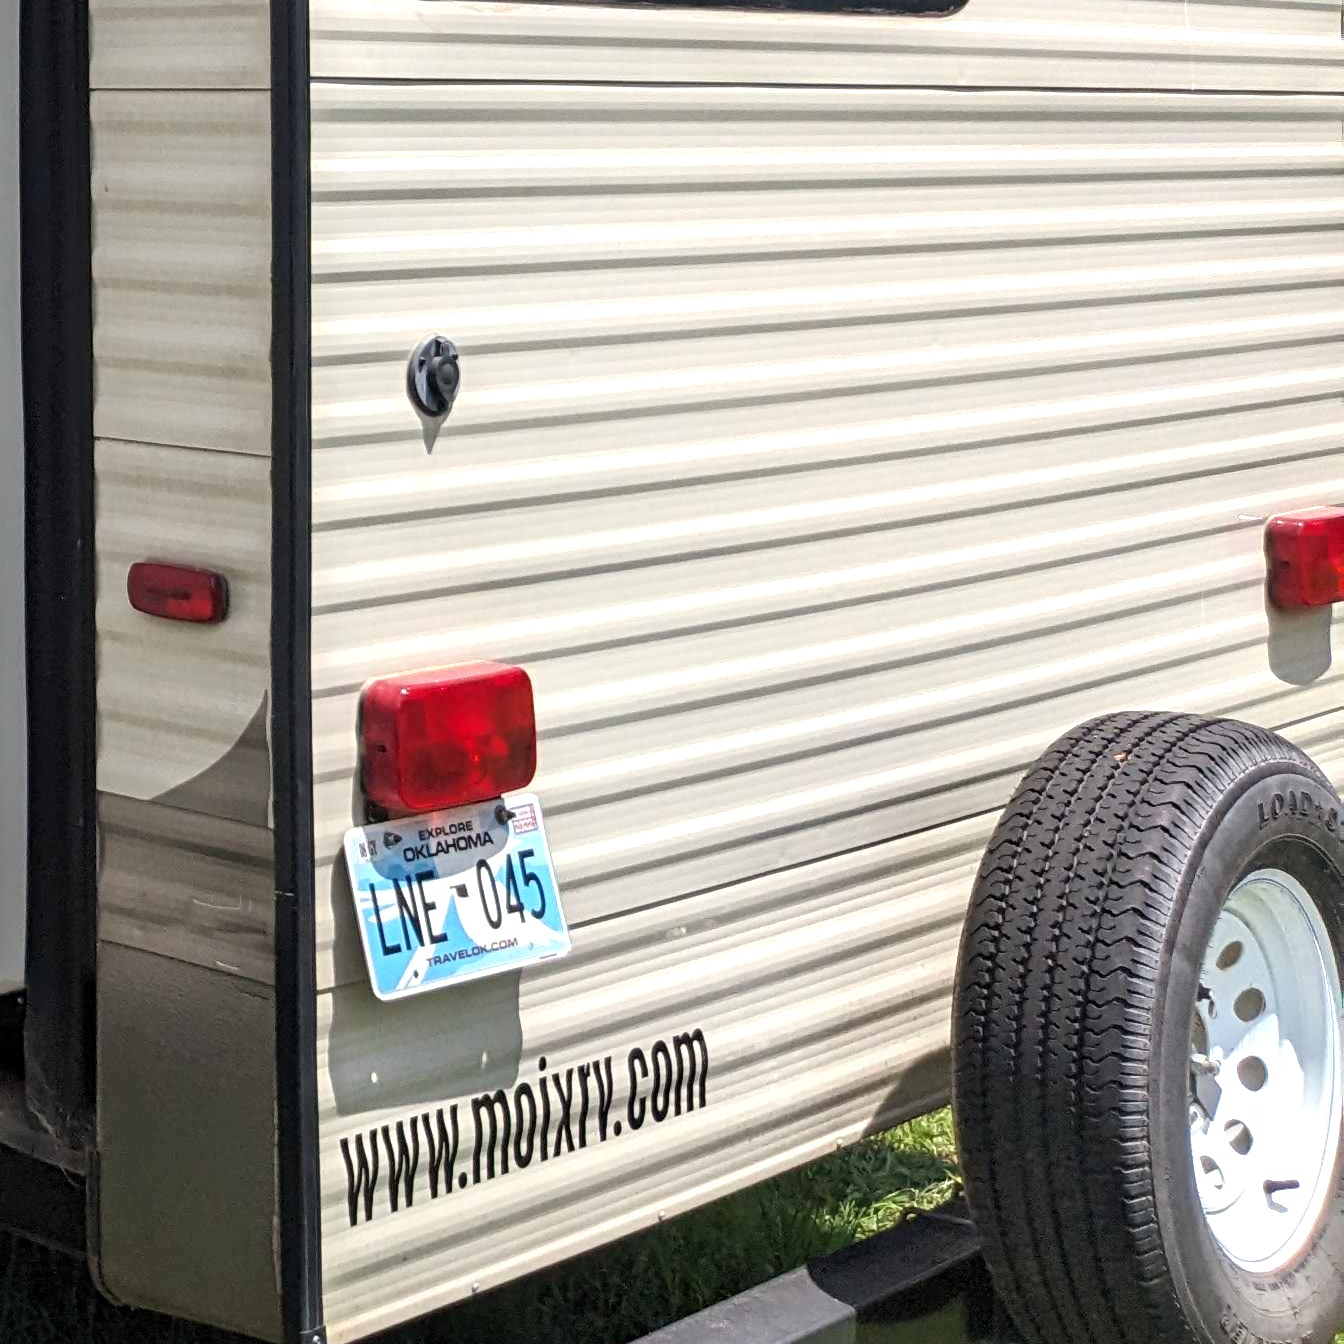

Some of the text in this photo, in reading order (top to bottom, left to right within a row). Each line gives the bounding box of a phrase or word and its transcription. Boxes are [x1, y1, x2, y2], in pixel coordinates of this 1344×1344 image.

[418, 821, 473, 841] EXPLORE
[403, 831, 494, 862] OKLAHOMA
[369, 849, 546, 956] LNE 045
[426, 937, 518, 967] TRAVELOK.COM
